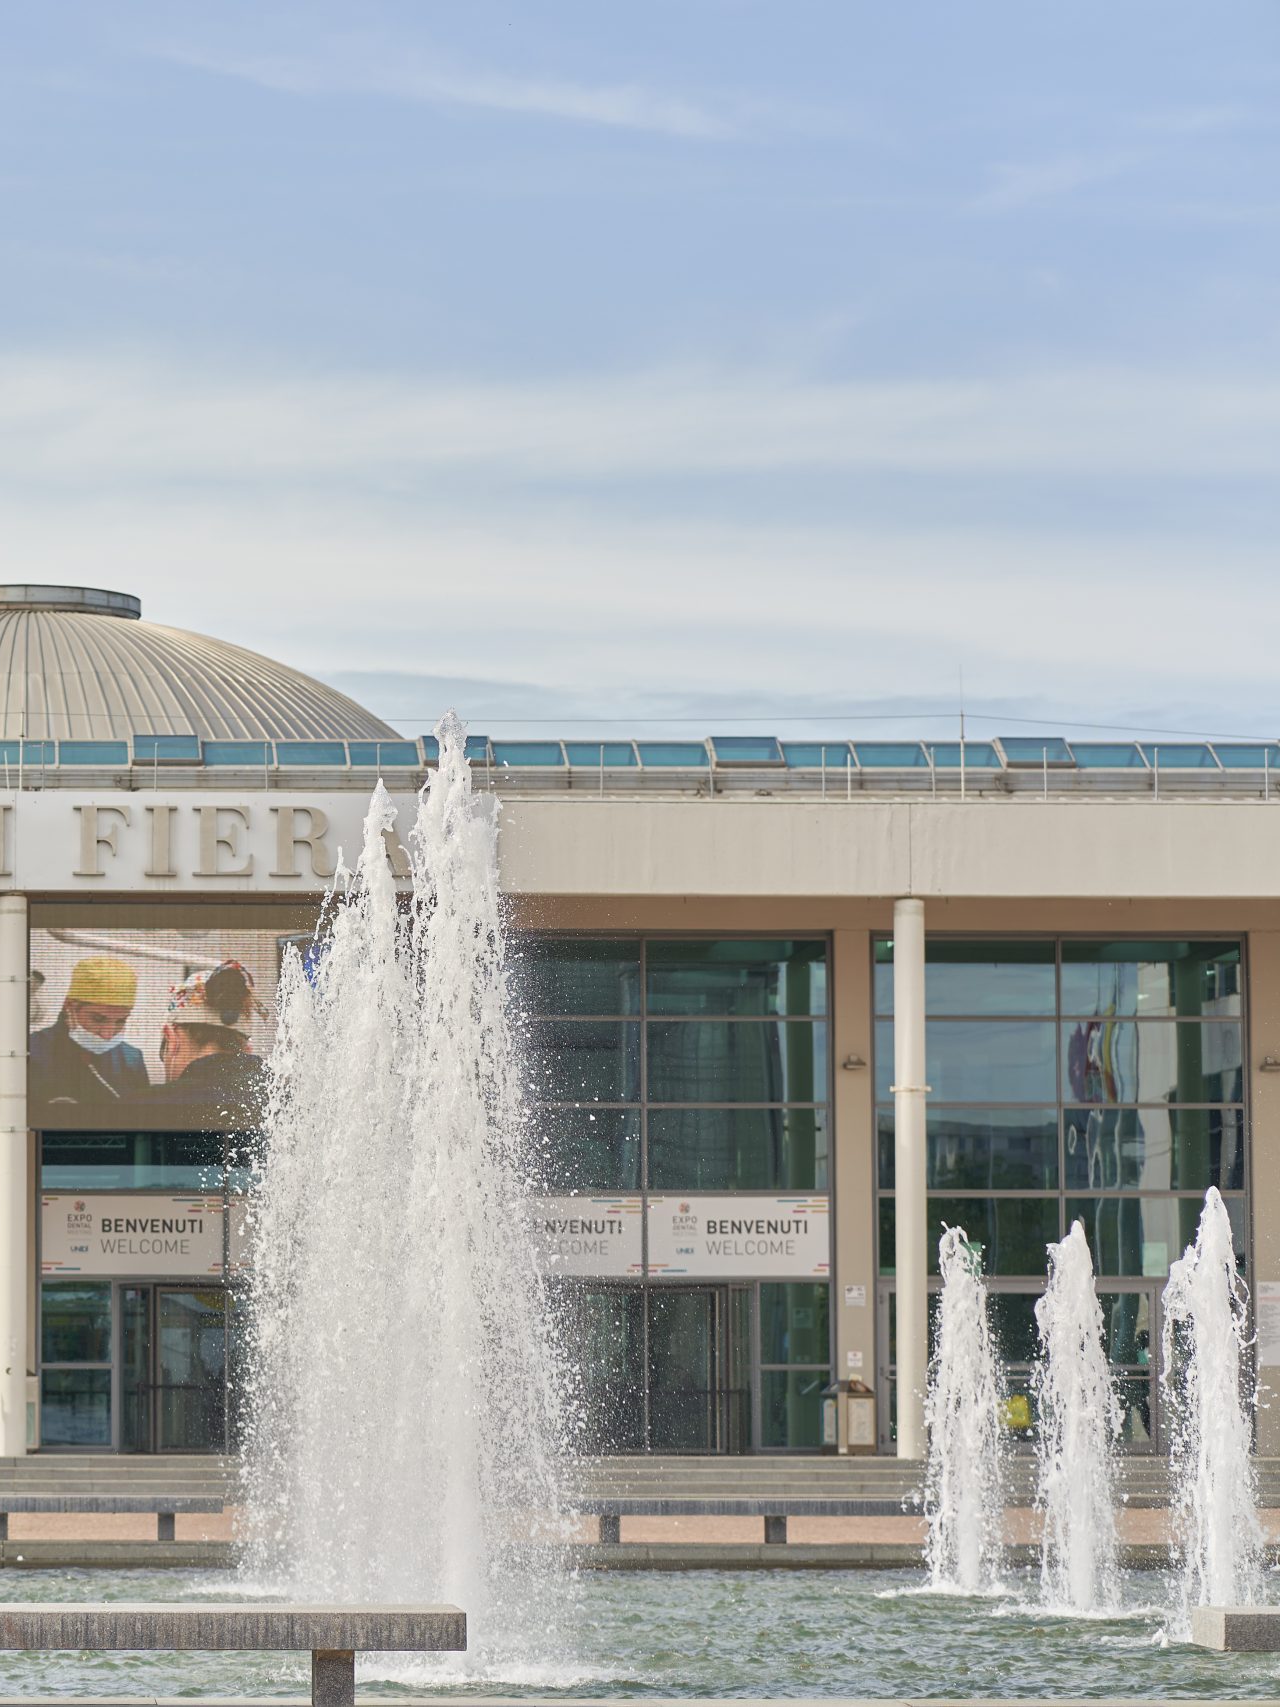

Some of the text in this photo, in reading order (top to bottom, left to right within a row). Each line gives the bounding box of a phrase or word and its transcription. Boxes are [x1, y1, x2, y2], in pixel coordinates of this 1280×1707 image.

[67, 1213, 93, 1222] EXPO
[672, 1215, 698, 1224] EXPO
[101, 1218, 203, 1234] BENVENUTI
[523, 1219, 623, 1235] ENVENUTI
[706, 1219, 808, 1235] BENVENUTI
[100, 1238, 190, 1255] WELCOME
[548, 1239, 609, 1256] COME
[705, 1239, 795, 1256] WELCOME
